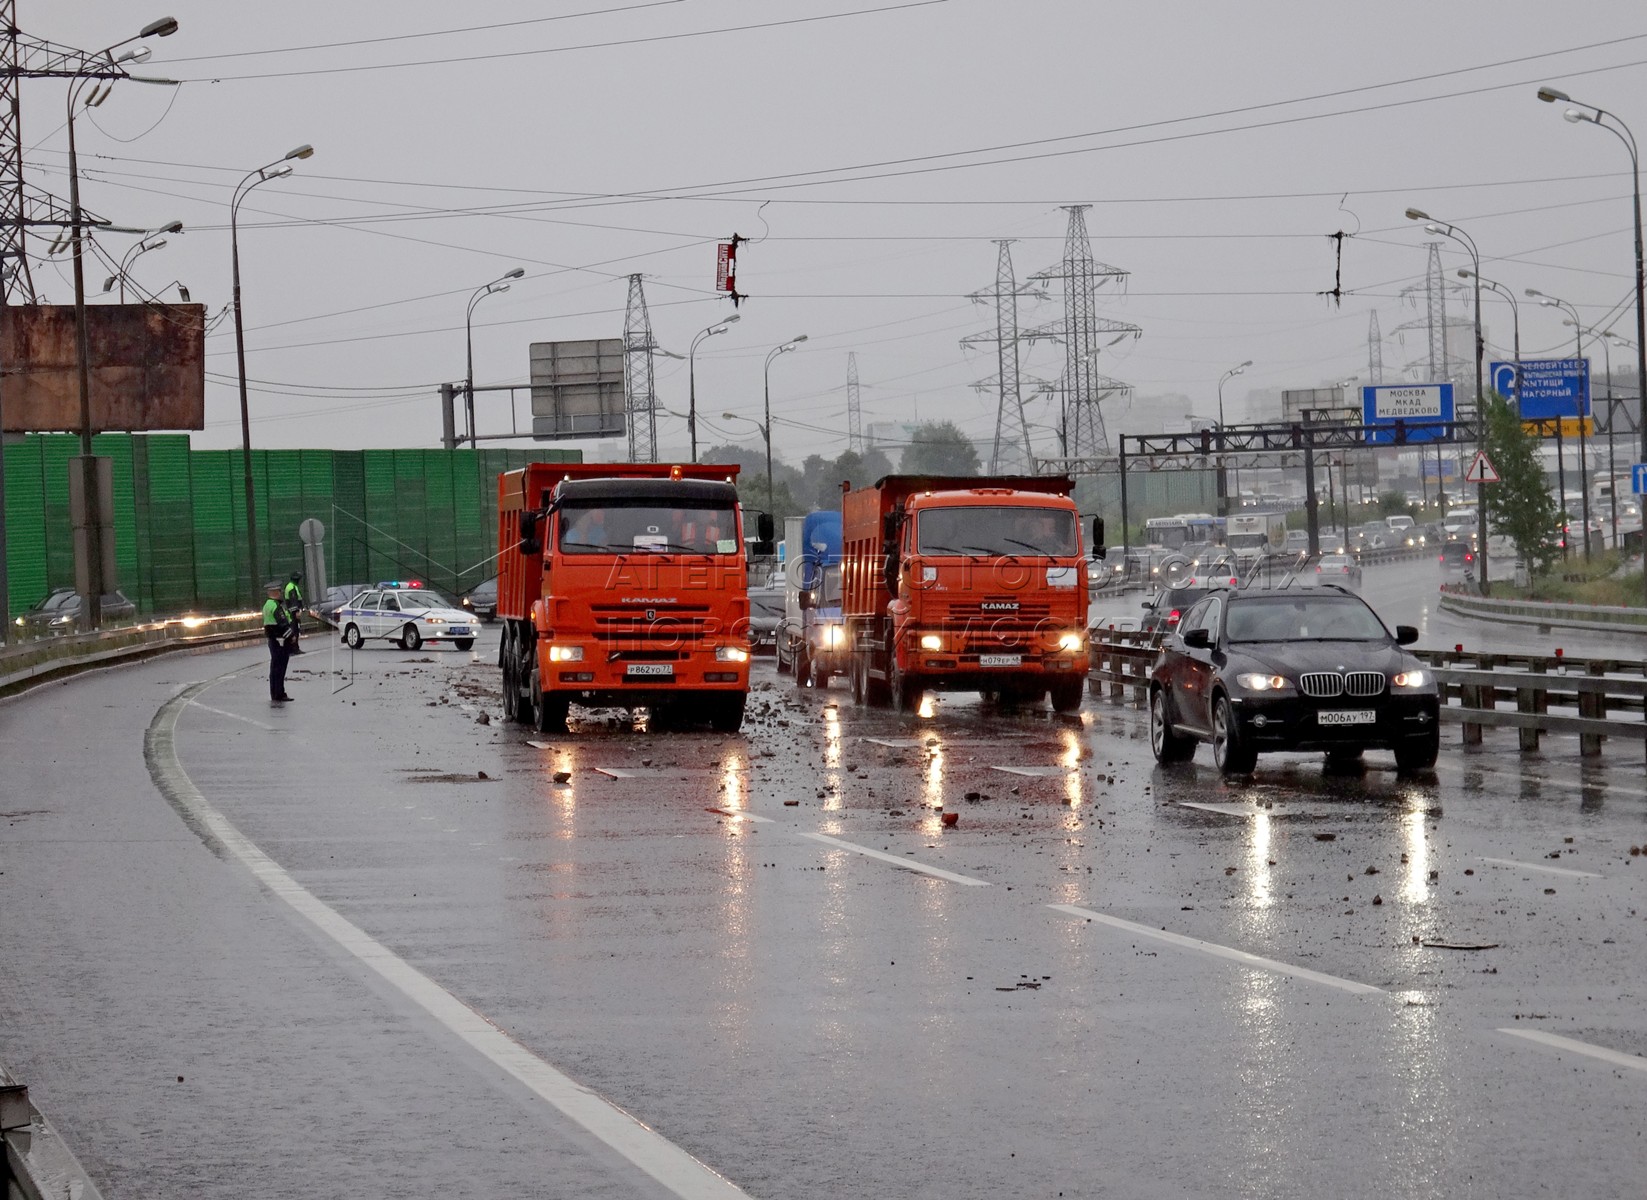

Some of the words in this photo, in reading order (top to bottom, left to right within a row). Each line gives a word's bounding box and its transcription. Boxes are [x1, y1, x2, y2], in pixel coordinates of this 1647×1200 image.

[1522, 379, 1564, 388] МЫТИЩИ
[1390, 389, 1426, 398] МОСКВА
[1522, 387, 1571, 398] НАГОРНЫЙ
[1395, 398, 1421, 406] МКАД
[1379, 407, 1439, 416] МЕДВЕДКОВО
[981, 602, 1020, 610] KAMAZ
